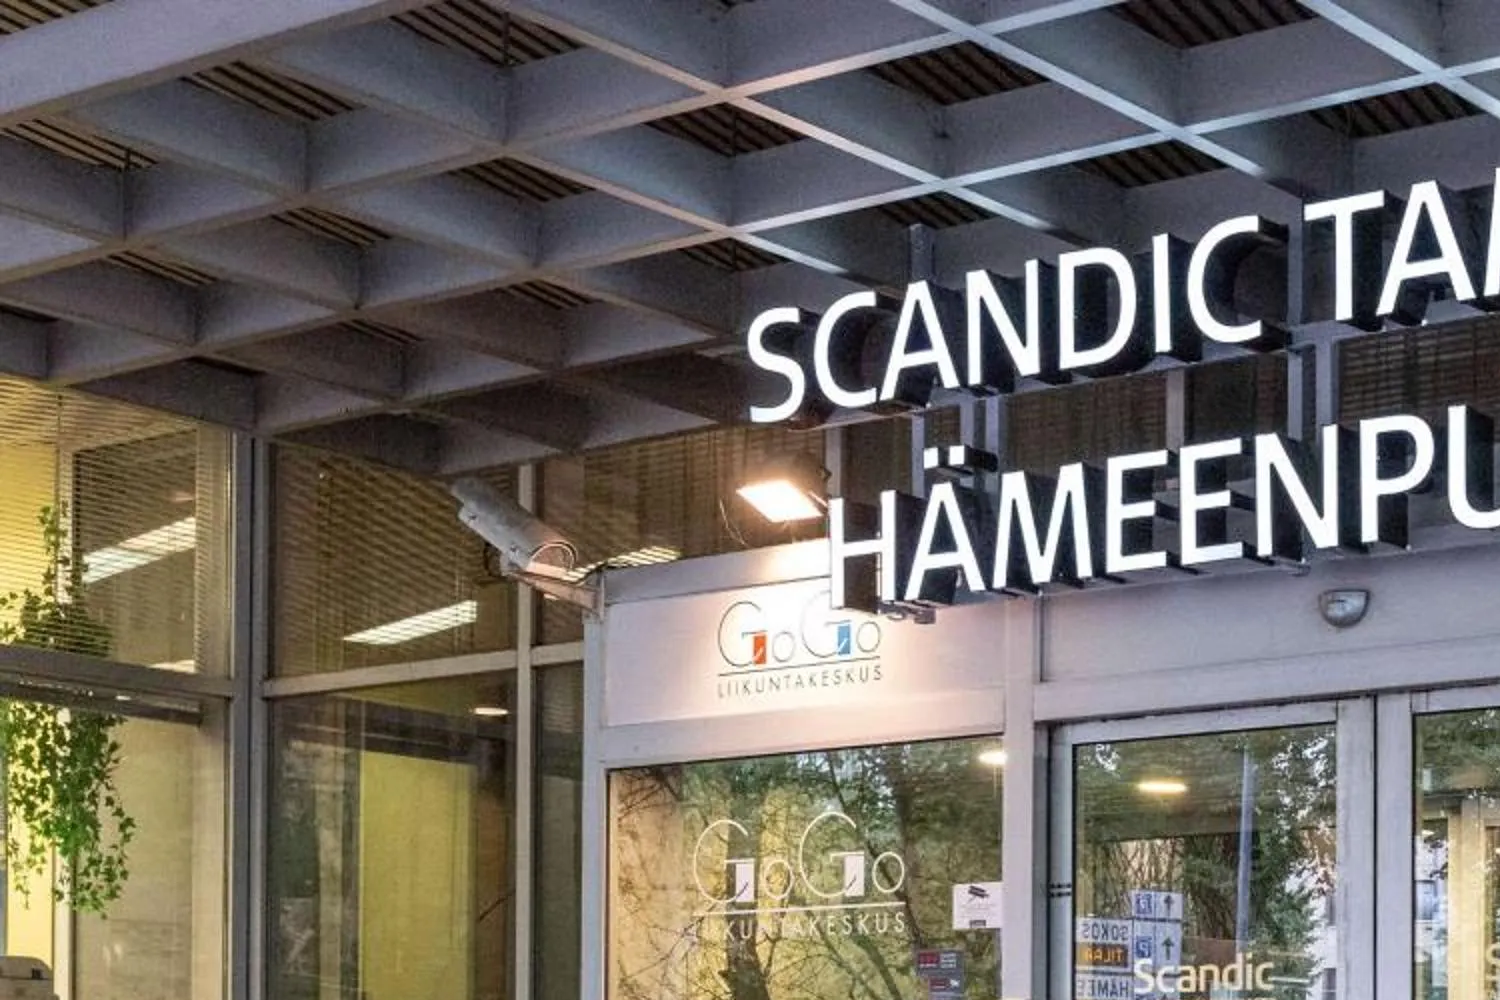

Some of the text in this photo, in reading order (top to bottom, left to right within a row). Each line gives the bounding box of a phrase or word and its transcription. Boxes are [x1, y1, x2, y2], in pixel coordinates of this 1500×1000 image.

[746, 215, 1263, 423] SCANDIC
[718, 589, 882, 668] GoGo
[717, 664, 883, 699] LIIKUNTAKESKUS
[694, 811, 905, 903] GoGo
[693, 911, 906, 943] KUNTAKESKUS
[1134, 952, 1274, 993] Scandic
